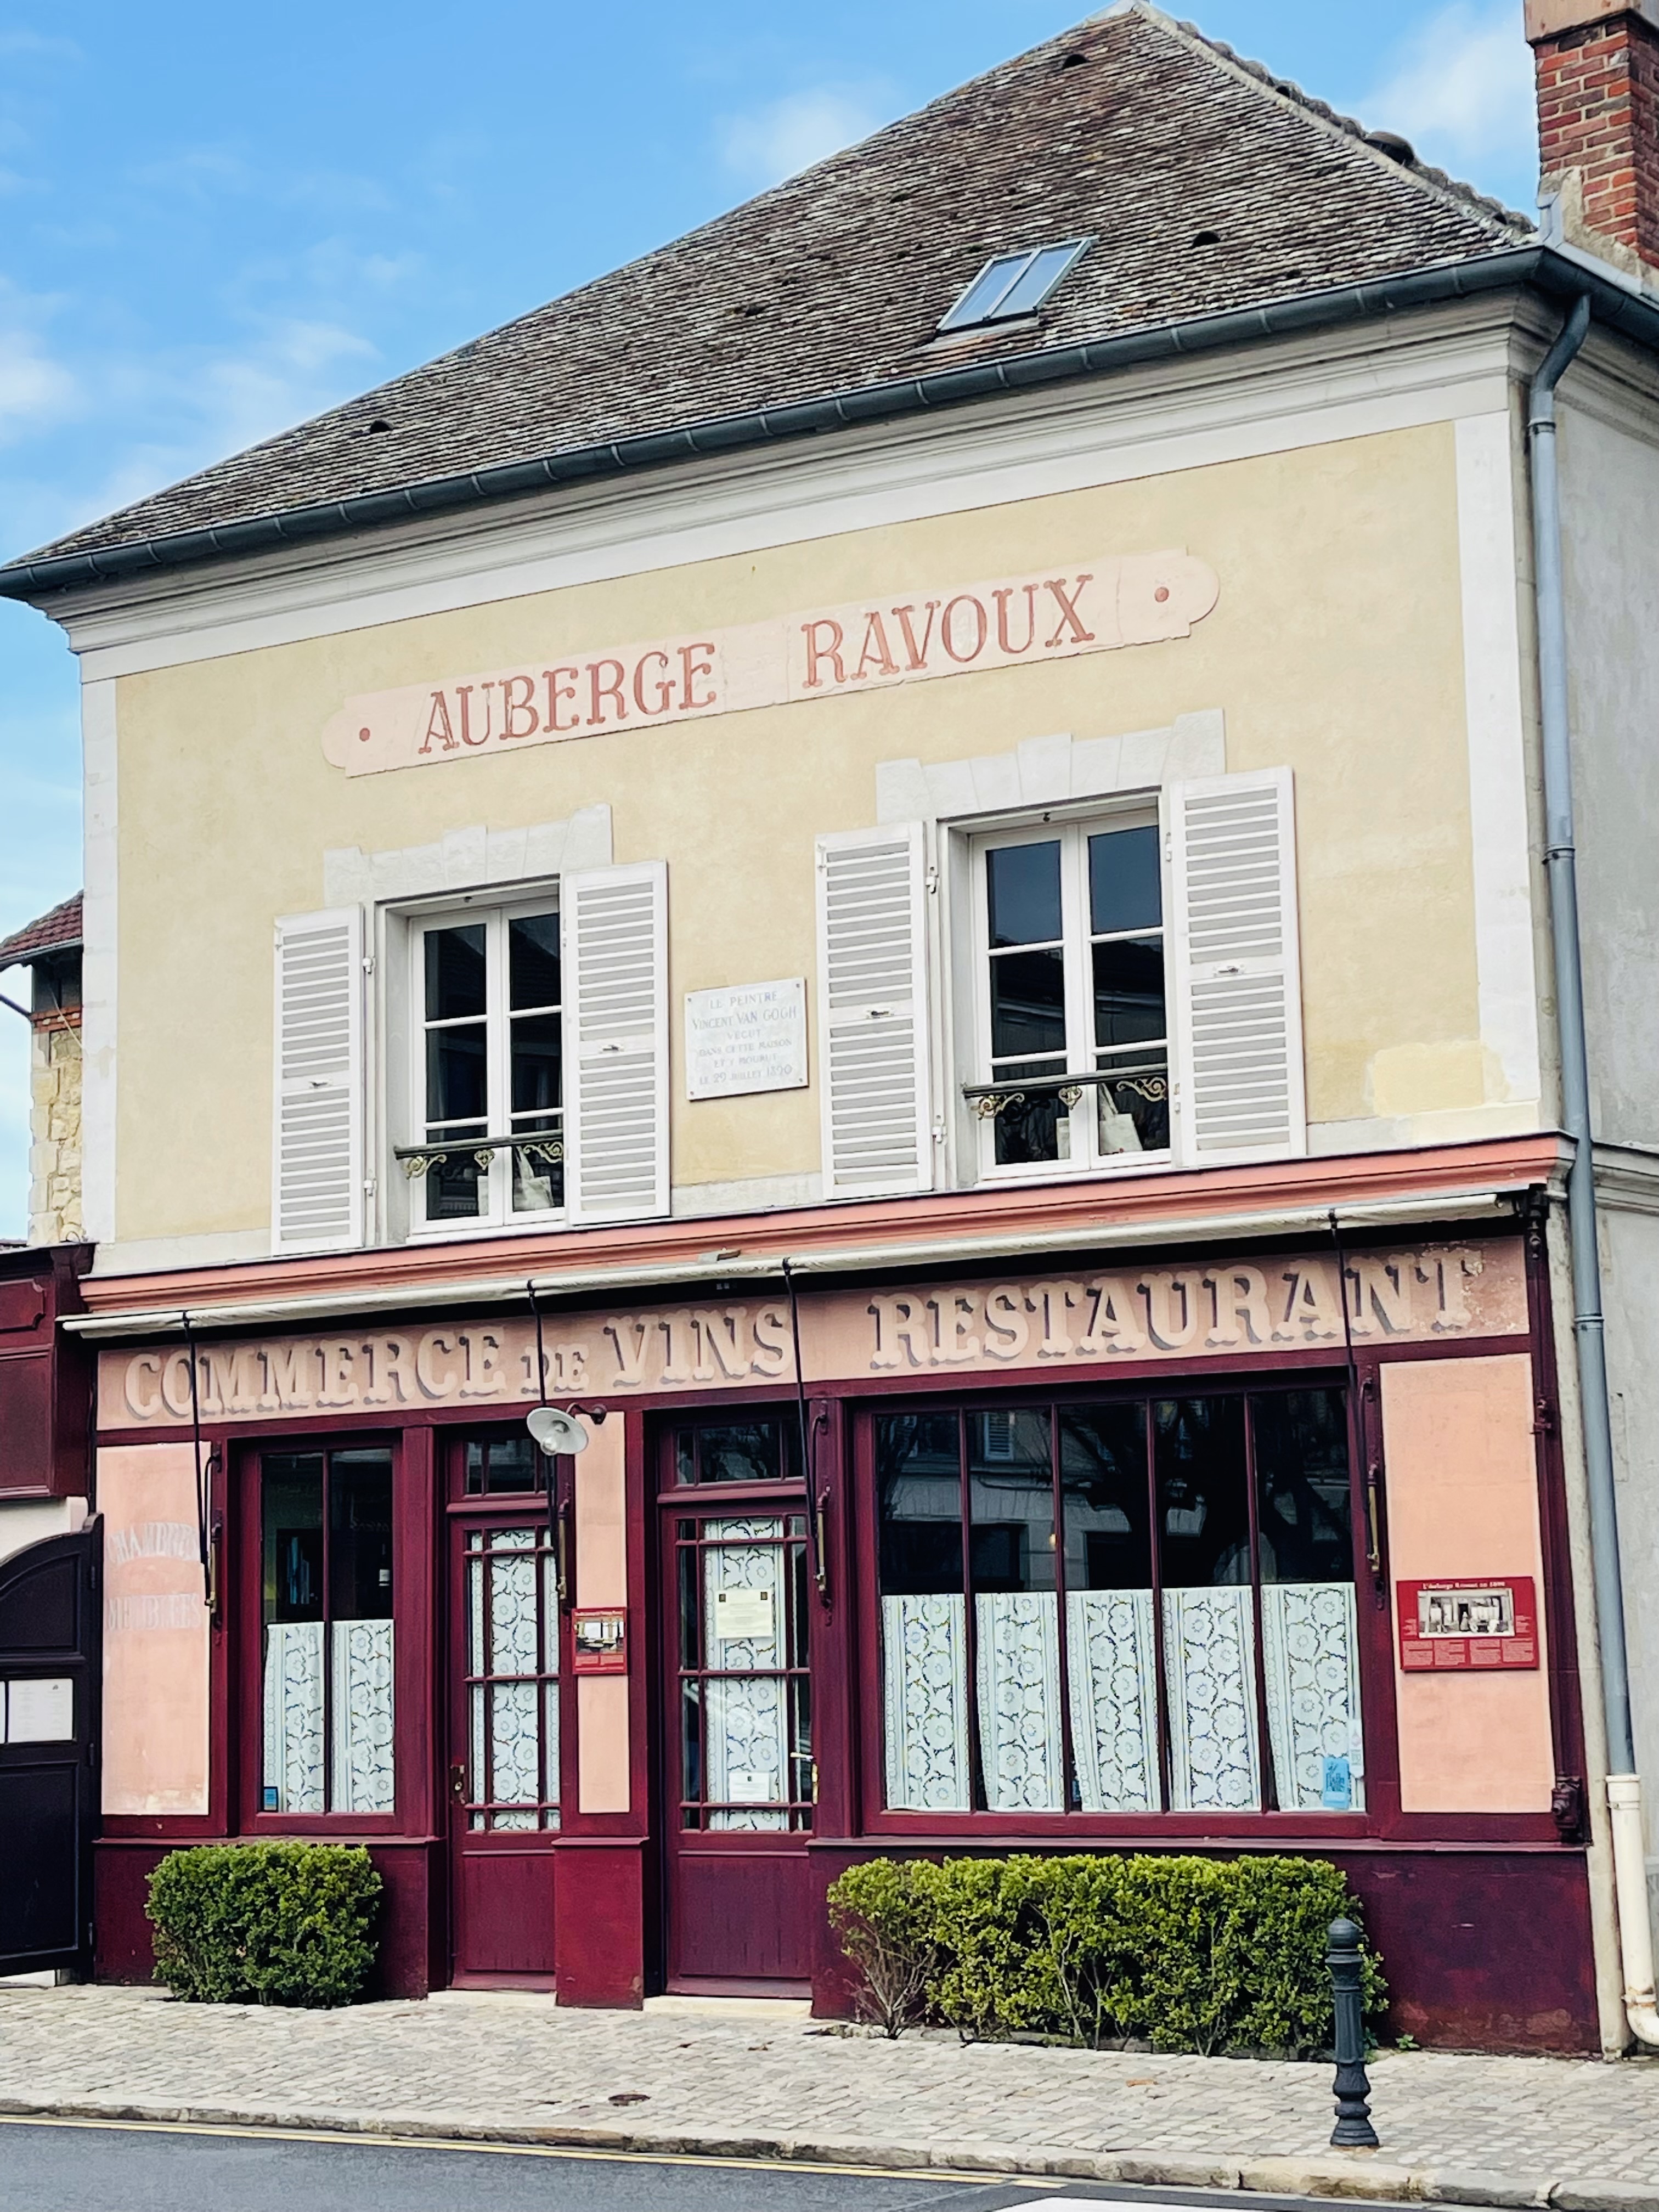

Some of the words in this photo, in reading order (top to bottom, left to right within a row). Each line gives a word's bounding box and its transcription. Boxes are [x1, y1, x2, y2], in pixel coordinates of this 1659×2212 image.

[418, 642, 717, 754] AUBERGE
[800, 574, 1096, 689] RAVOUX
[710, 999, 723, 1009] LE
[730, 991, 778, 1007] PEINTRE
[692, 1016, 733, 1030] VINCENT
[737, 1011, 758, 1024] VAN
[763, 1005, 797, 1022] GOGH
[713, 1071, 727, 1084] 29
[767, 1064, 793, 1077] 1890
[125, 1326, 506, 1420] COMMERCE
[521, 1344, 589, 1394] DE
[604, 1303, 794, 1386] VINS
[867, 1248, 1483, 1369] RESTAURANT
